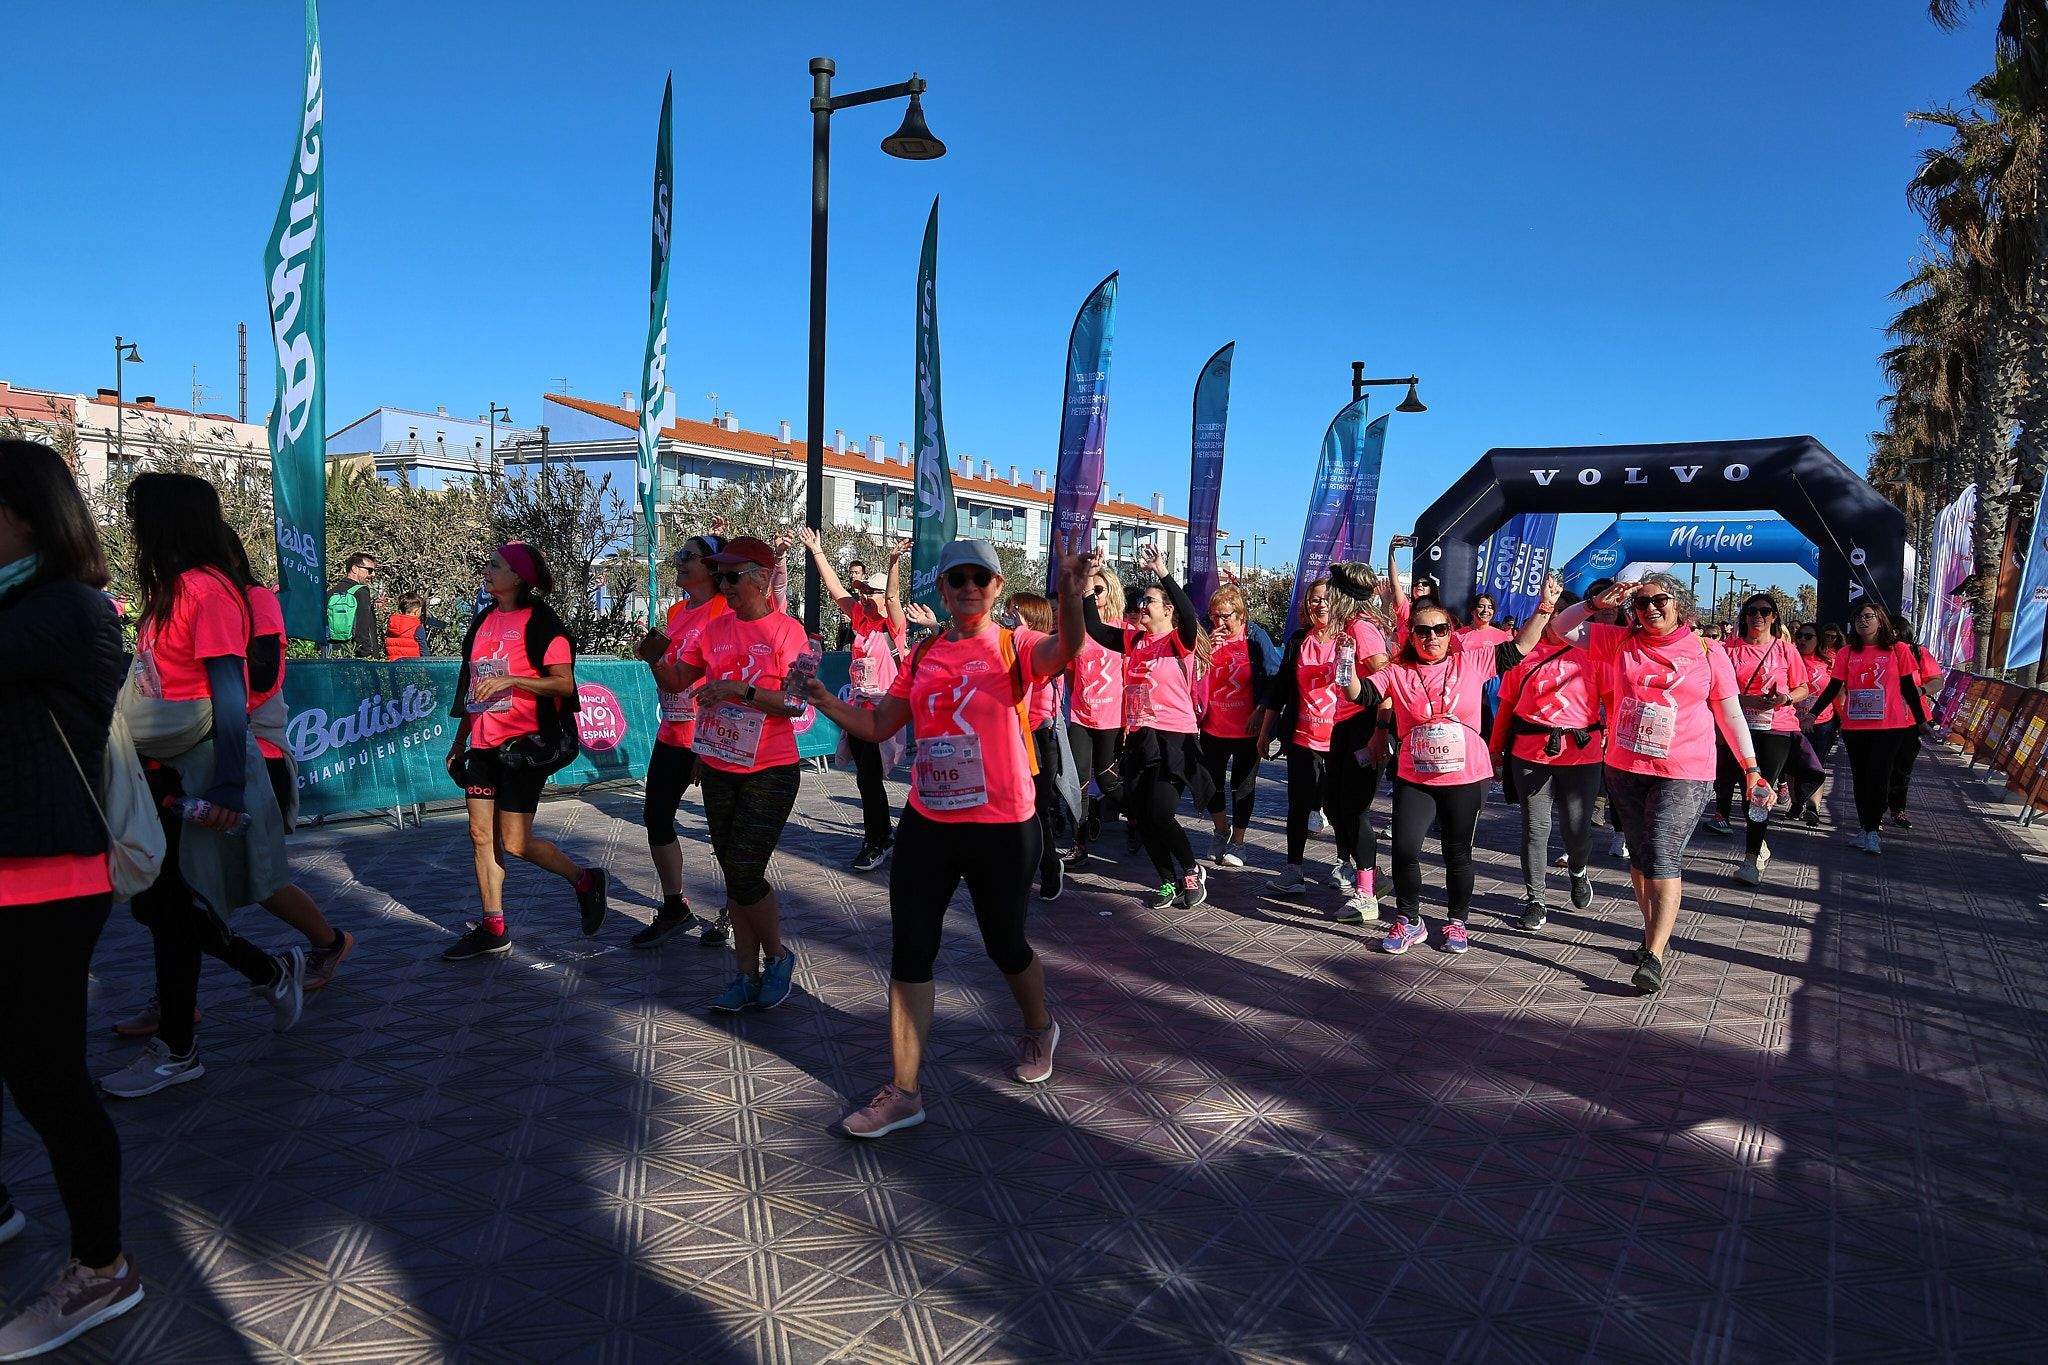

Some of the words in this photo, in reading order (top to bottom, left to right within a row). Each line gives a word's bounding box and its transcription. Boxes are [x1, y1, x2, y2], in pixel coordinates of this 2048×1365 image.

[1529, 463, 1750, 486] VOLVO
[1669, 525, 1753, 558] Marlene
[1495, 536, 1515, 590] GOYA
[1527, 548, 1545, 597] GOYA
[285, 683, 438, 762] Batiste
[582, 727, 617, 740] ESPAÑA
[717, 726, 740, 741] 016
[1632, 724, 1654, 735] 016
[297, 749, 369, 789] CHAMPÚ
[377, 741, 396, 759] EN
[402, 724, 443, 748] SECO
[1428, 745, 1450, 755] 016
[933, 768, 960, 782] 016
